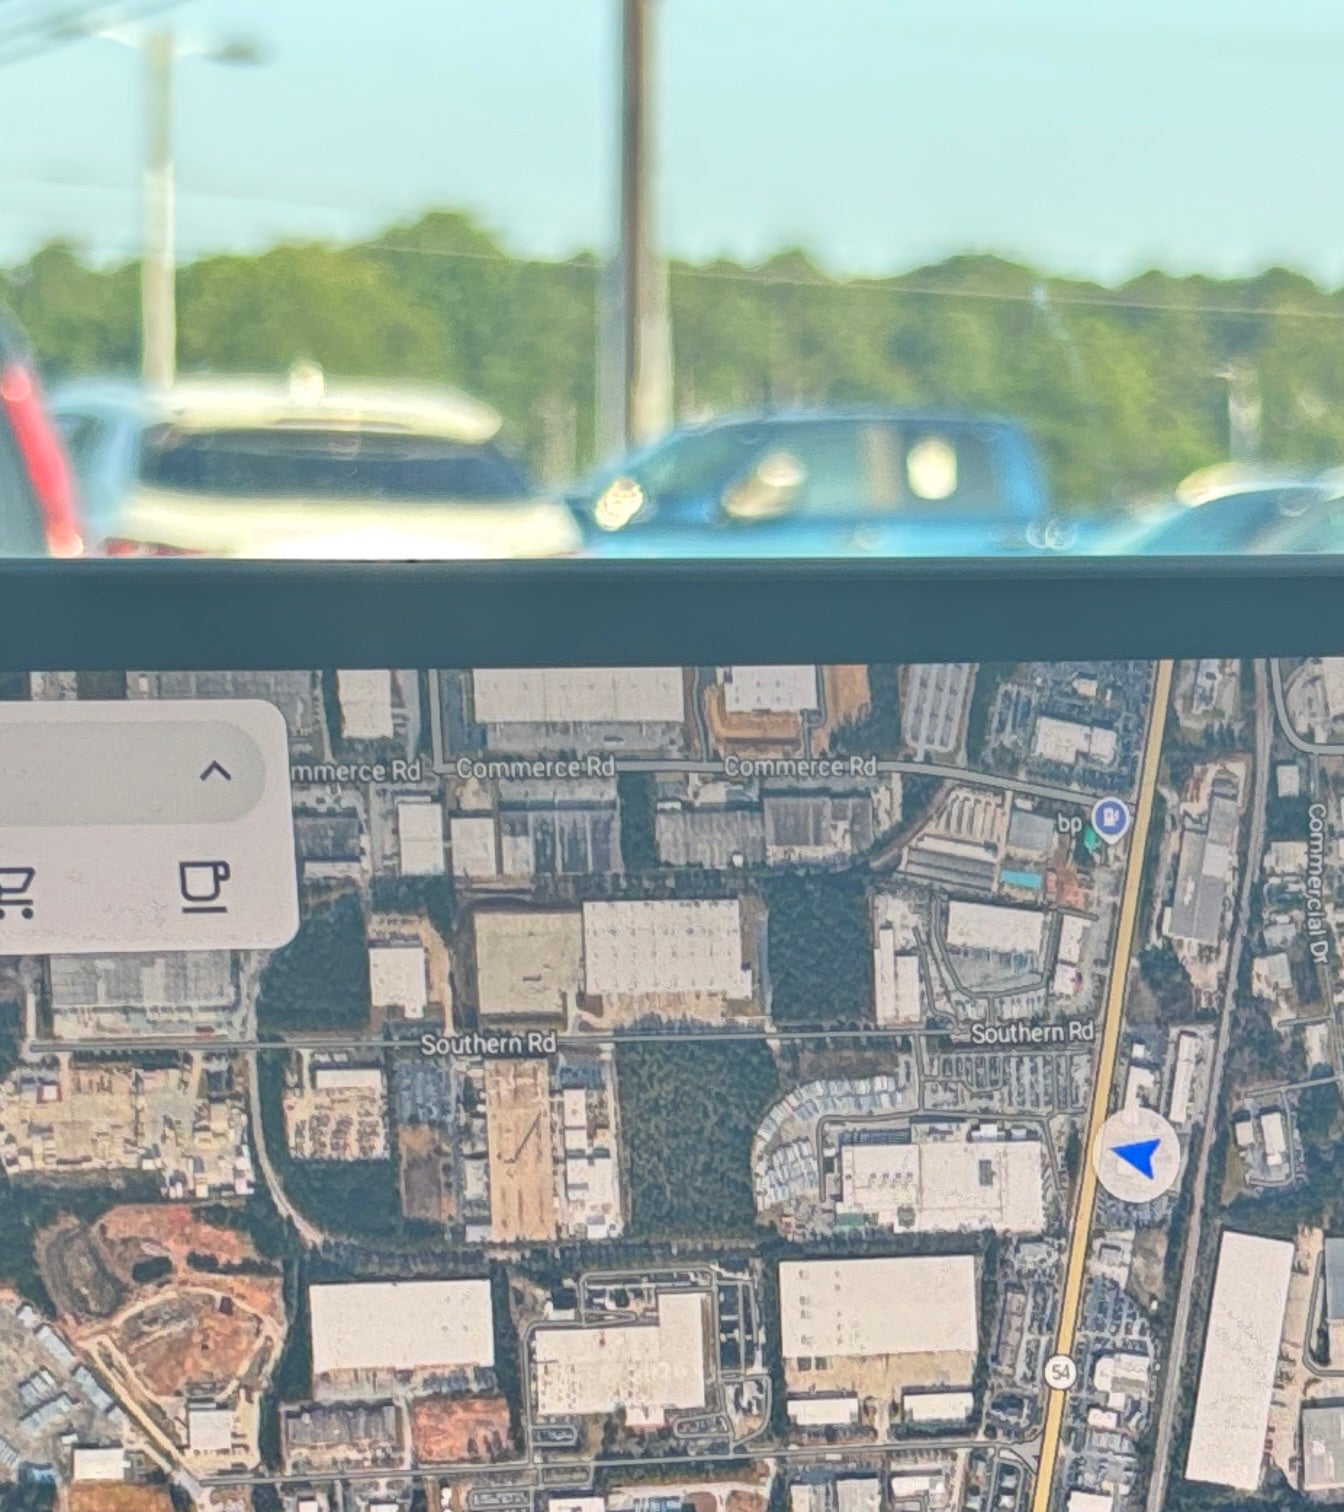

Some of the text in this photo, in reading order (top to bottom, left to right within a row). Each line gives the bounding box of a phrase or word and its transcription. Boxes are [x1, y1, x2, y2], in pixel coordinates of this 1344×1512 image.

[391, 760, 421, 781] Rd
[456, 755, 616, 779] Commerce Rd
[723, 756, 877, 777] Commerce Rd
[1058, 812, 1083, 834] bp
[1307, 803, 1329, 964] Commercial Dr
[971, 1020, 1094, 1044] Southern Rd
[421, 1032, 556, 1056] Southern Rd
[1051, 1363, 1071, 1381] 54
